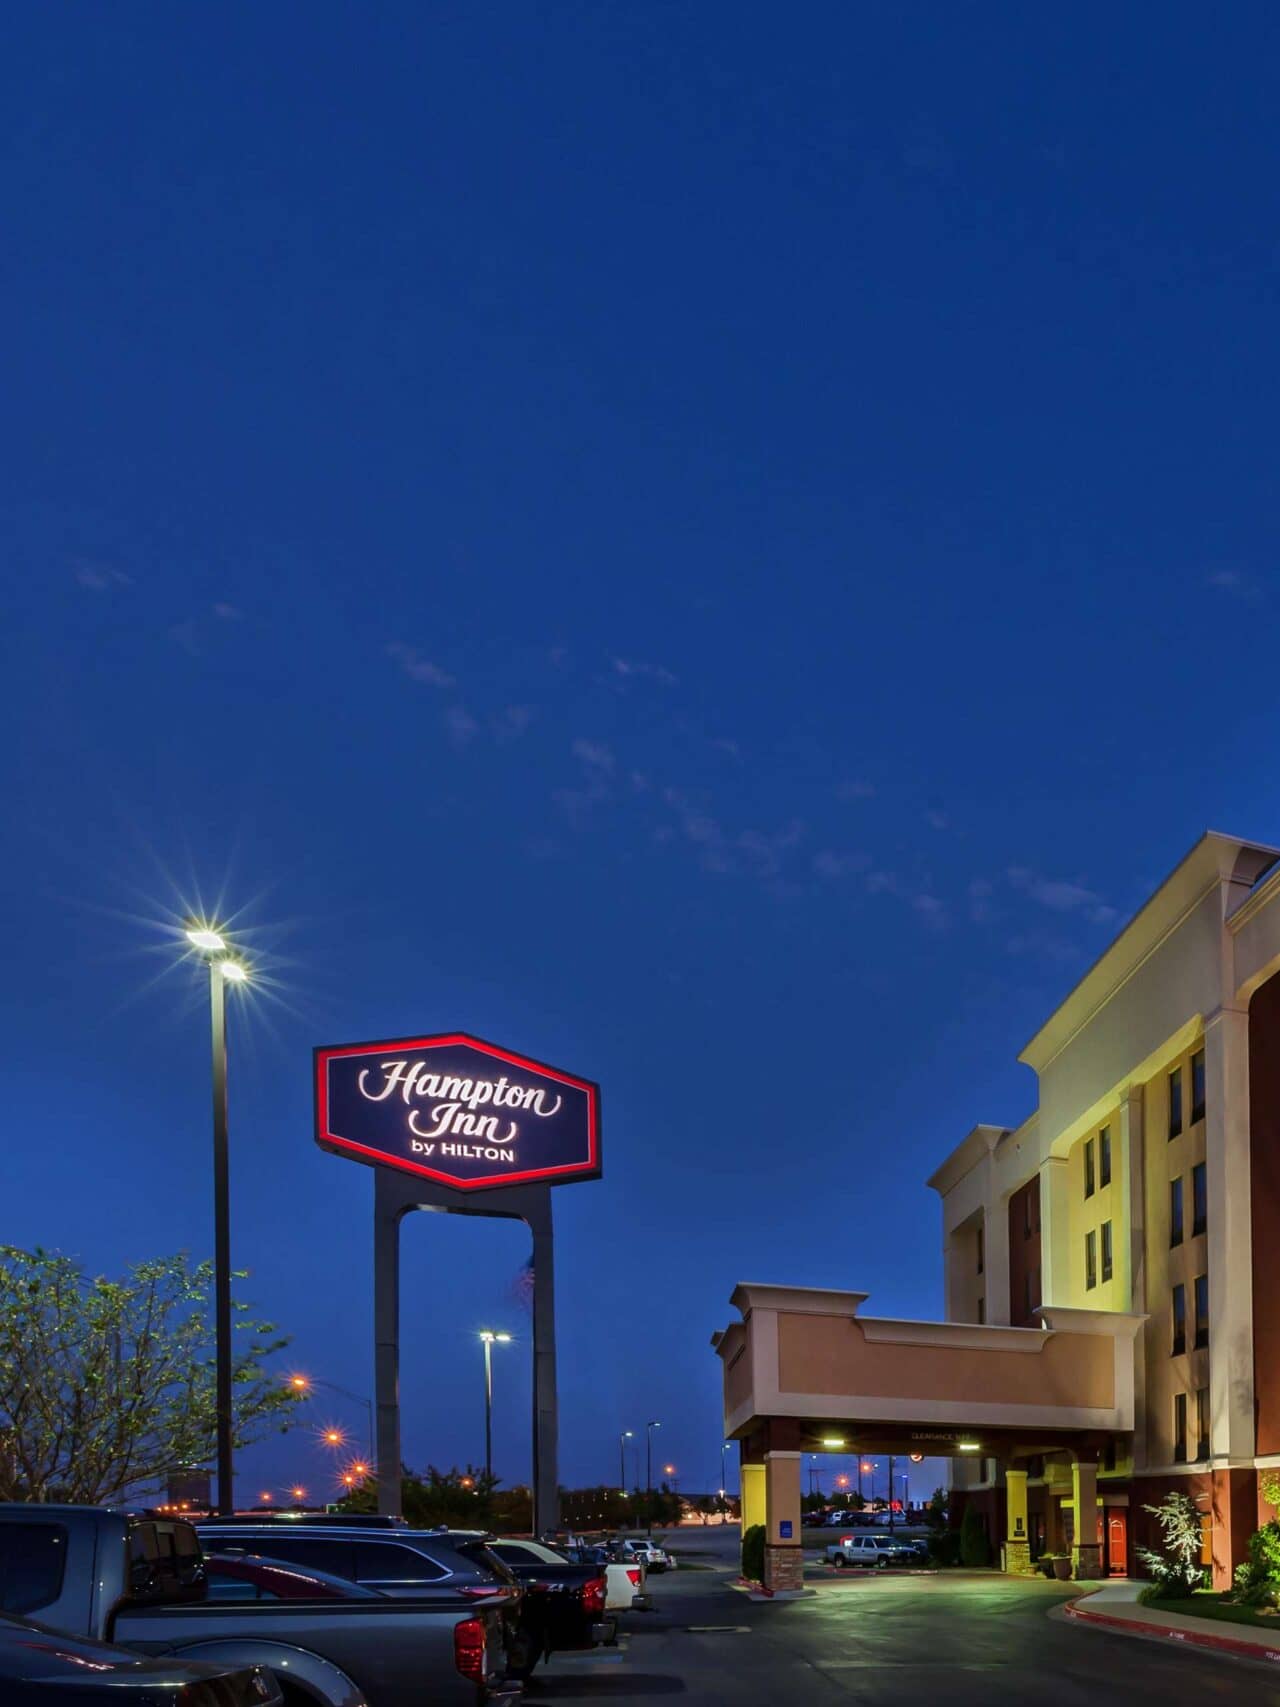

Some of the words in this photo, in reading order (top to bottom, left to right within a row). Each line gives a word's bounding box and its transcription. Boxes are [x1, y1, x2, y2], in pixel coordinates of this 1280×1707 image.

[358, 1061, 562, 1117] Hampton
[408, 1103, 517, 1144] Inn
[411, 1139, 434, 1156] by
[441, 1142, 515, 1162] HILTON
